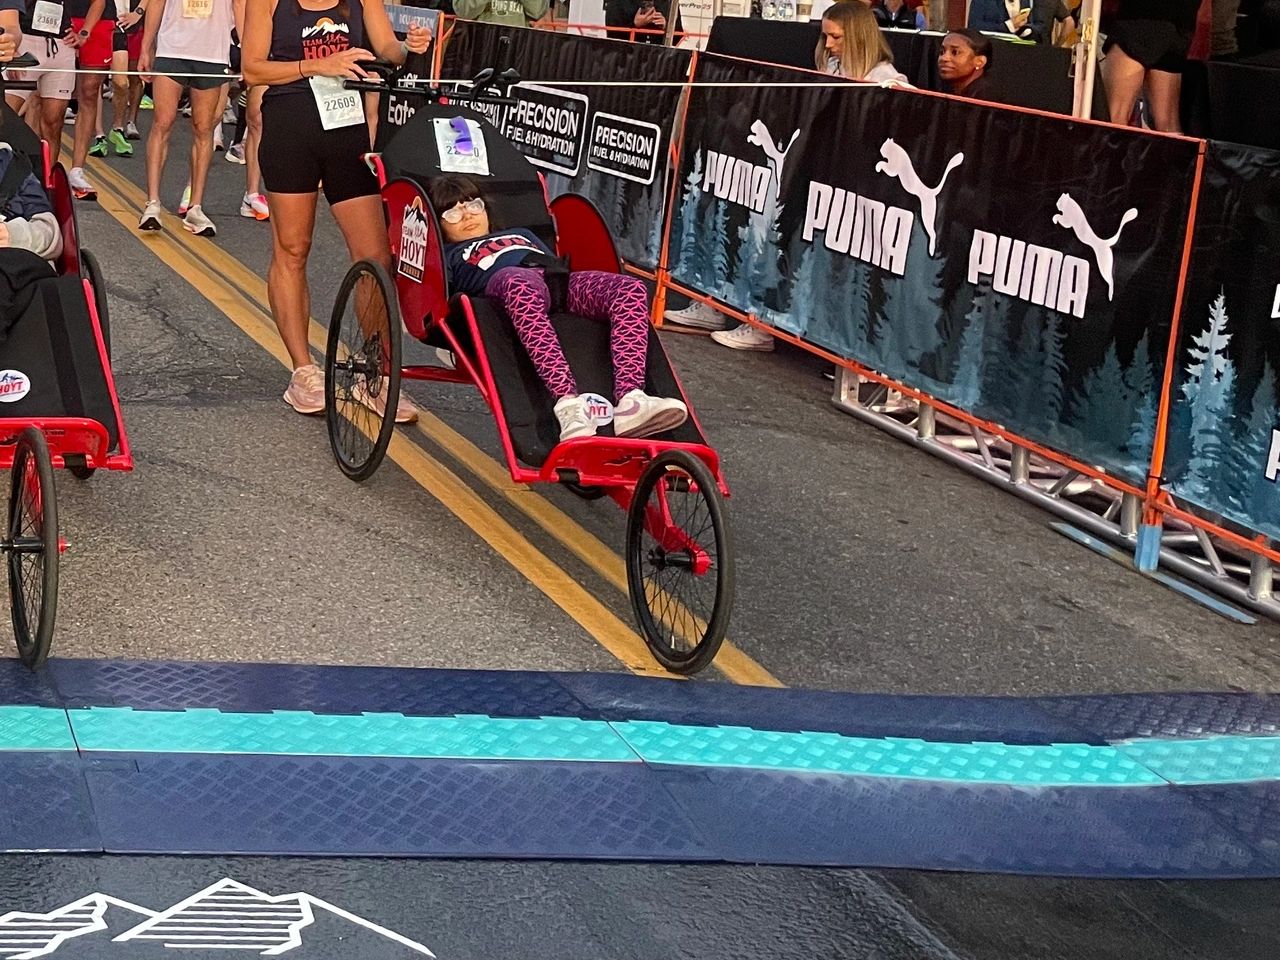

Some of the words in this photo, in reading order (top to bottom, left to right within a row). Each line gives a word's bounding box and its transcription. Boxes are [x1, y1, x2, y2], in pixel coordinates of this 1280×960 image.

[302, 38, 323, 47] TEAM
[324, 96, 356, 111] 22609
[509, 100, 579, 137] PRECISION
[446, 145, 480, 157] 220
[525, 130, 531, 144] &
[531, 131, 575, 156] HYDRATION
[595, 125, 653, 156] PRECISION
[593, 145, 608, 159] FUEL
[609, 150, 615, 161] &
[614, 151, 650, 170] HYDRATION
[703, 149, 771, 213] PUMA
[802, 180, 914, 275] PUMA
[401, 237, 425, 266] HOYT
[968, 229, 1090, 318] PUMA
[590, 406, 607, 416] OYT
